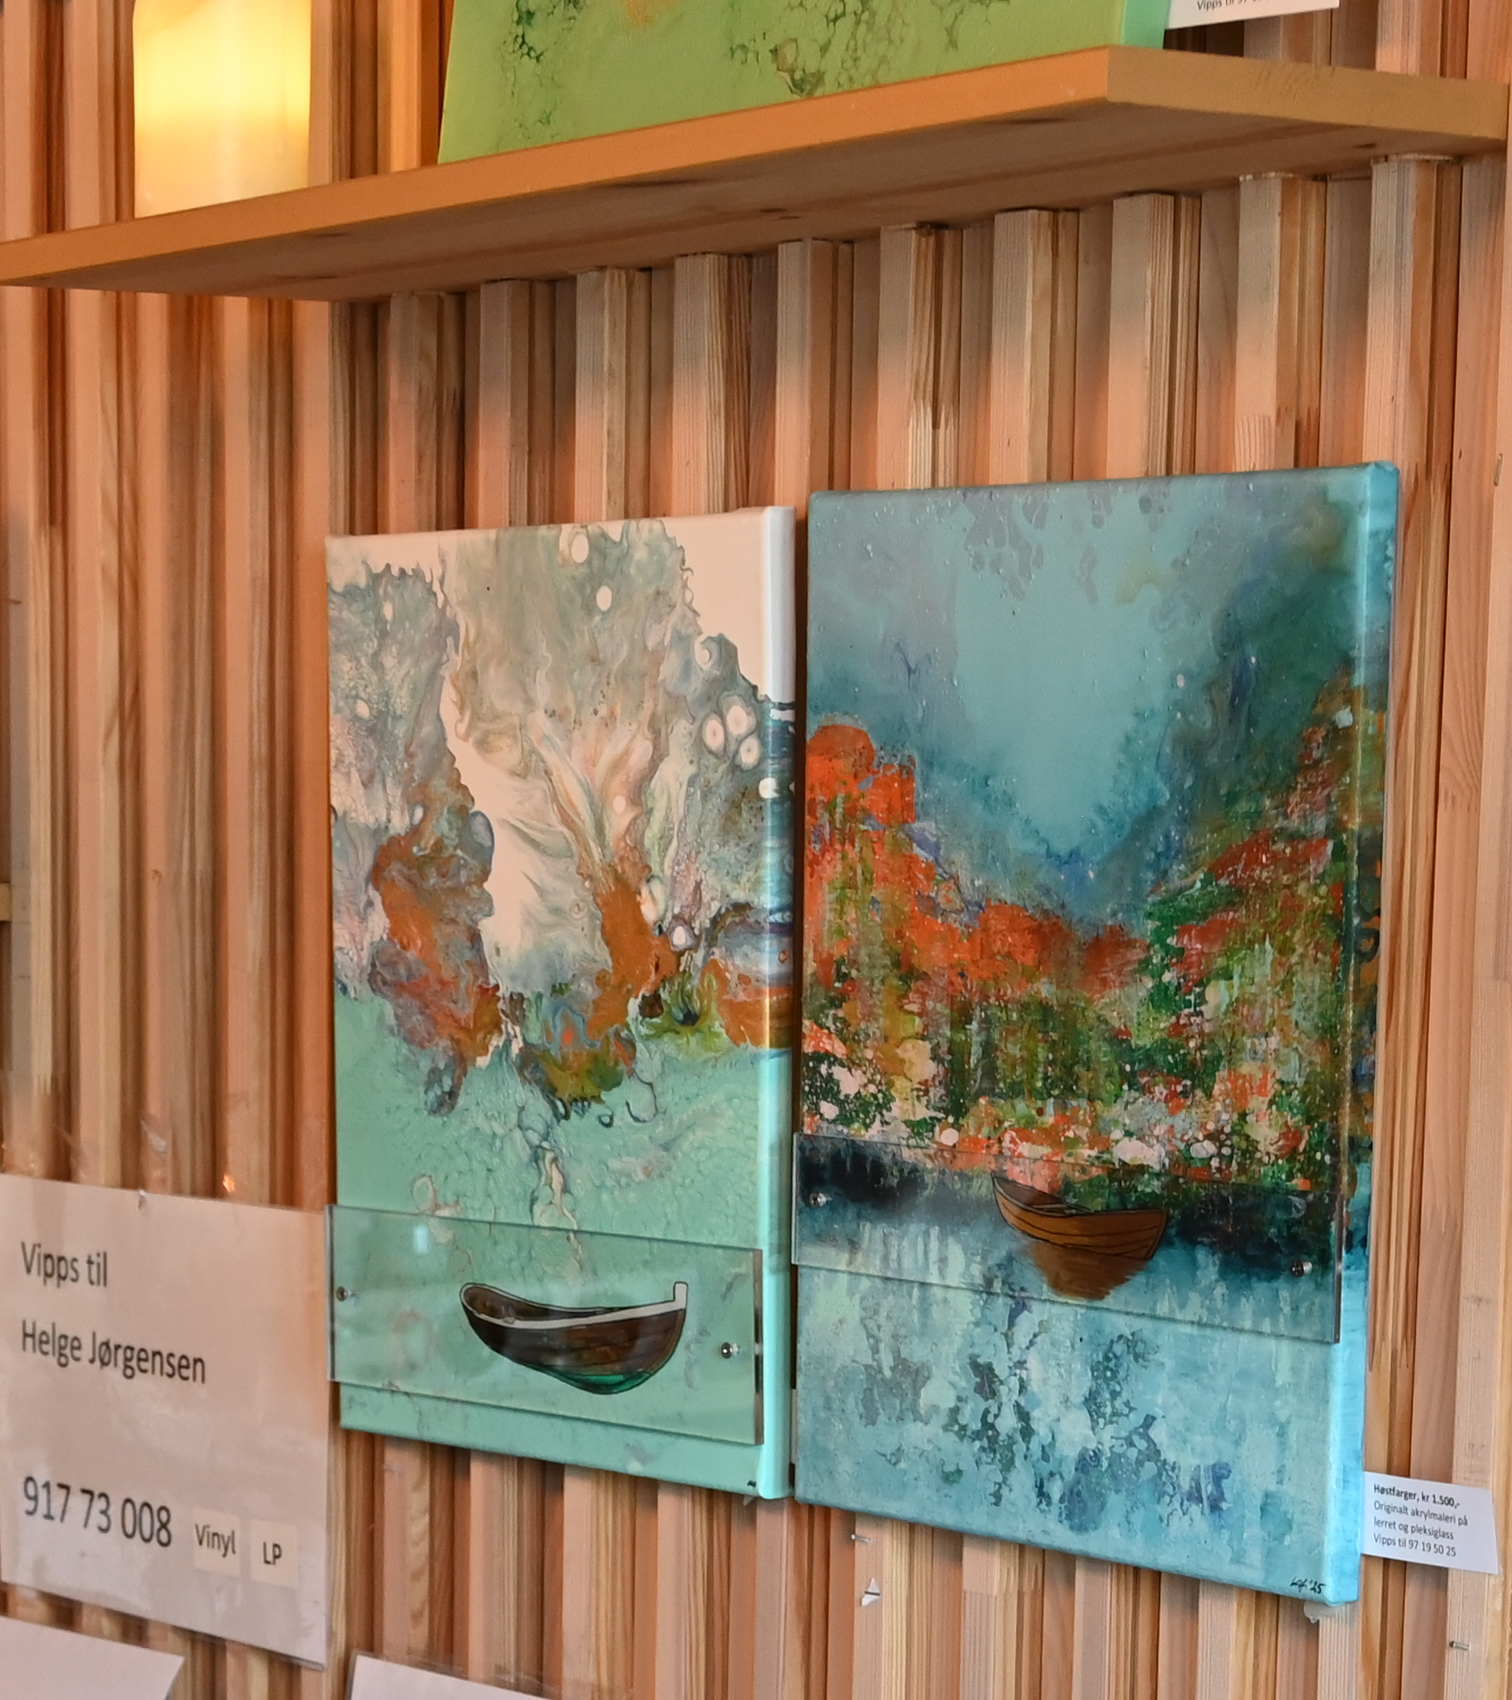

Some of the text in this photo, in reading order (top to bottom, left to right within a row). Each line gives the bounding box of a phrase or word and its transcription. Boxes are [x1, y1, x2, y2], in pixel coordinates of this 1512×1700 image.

[20, 1240, 108, 1290] Vipps til
[21, 1319, 207, 1385] Helge Jørgensen
[1373, 1483, 1420, 1503] Høstfarger,
[1421, 1491, 1430, 1503] kr
[23, 1475, 173, 1549] 917 73 008
[1373, 1500, 1468, 1527] Originalt akrylmaleri på
[194, 1523, 238, 1558] Vinyl
[1373, 1517, 1454, 1541] lerret og pleksiglass
[262, 1540, 283, 1567] LP
[1373, 1533, 1457, 1557] Vipps til 97 19 50 25
